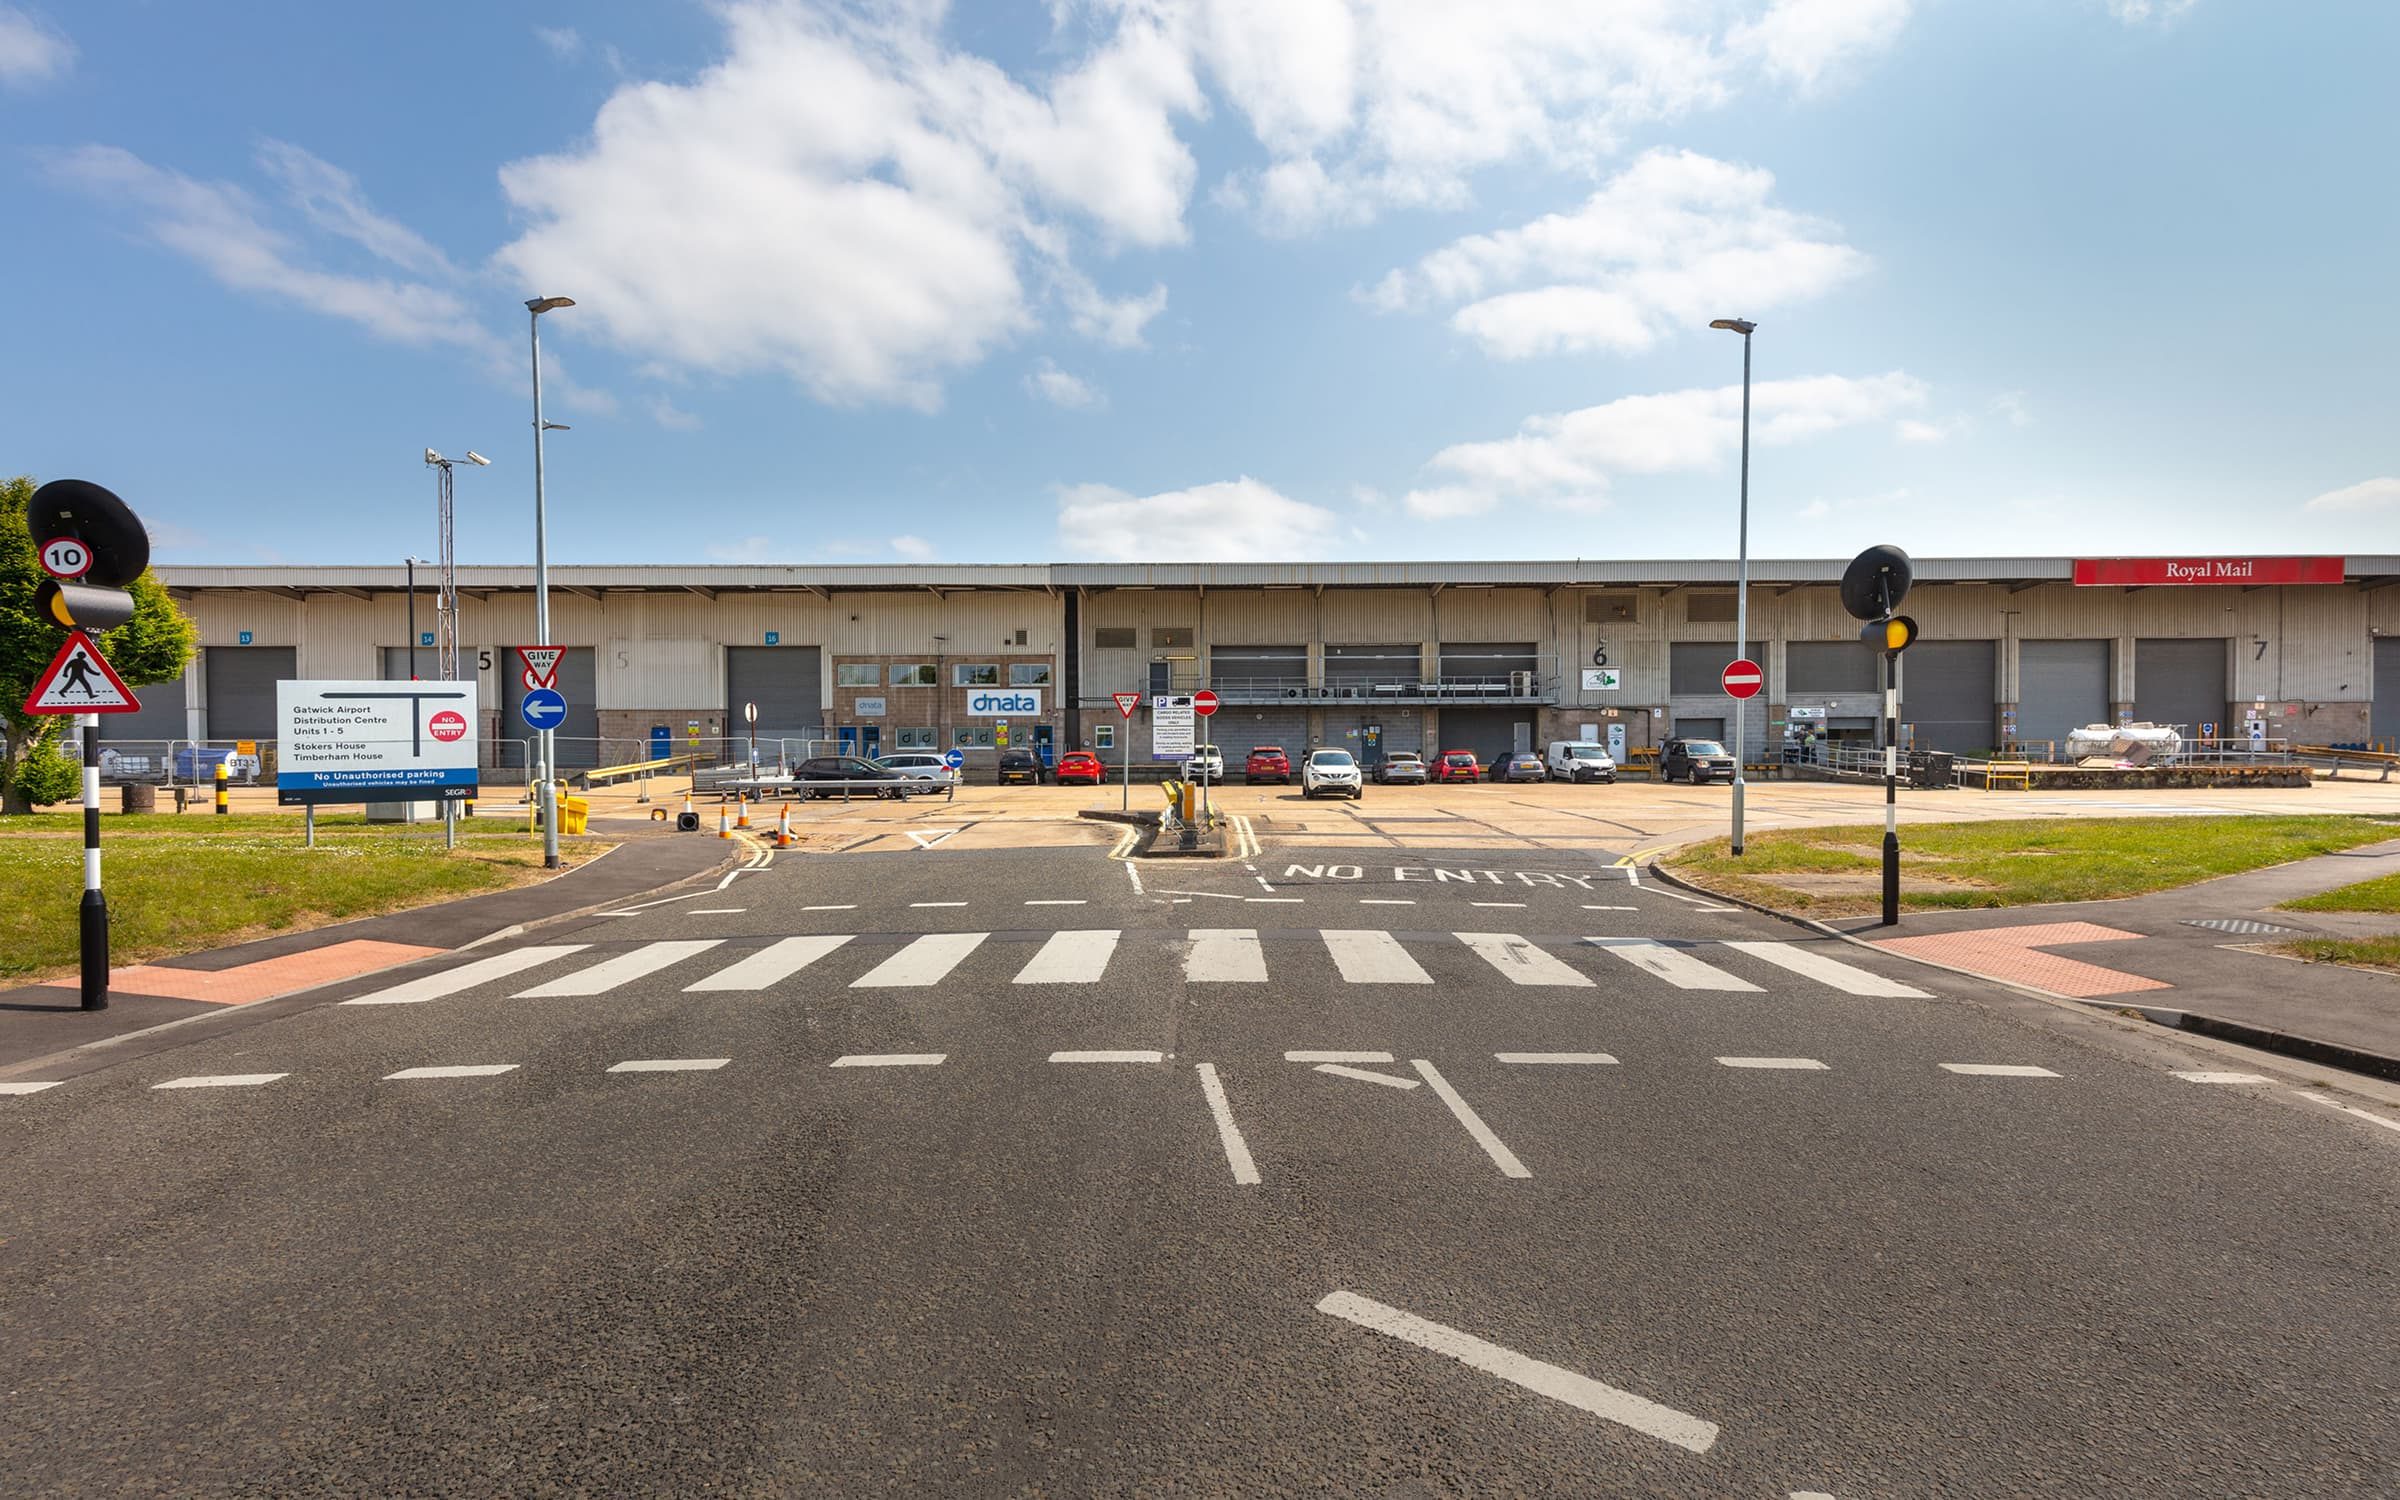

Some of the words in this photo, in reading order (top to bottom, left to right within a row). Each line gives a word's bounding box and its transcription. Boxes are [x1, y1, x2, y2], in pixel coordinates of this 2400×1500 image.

[50, 549, 81, 566] 10
[2166, 562, 2211, 581] Royal
[2216, 562, 2253, 577] Mail
[527, 651, 555, 660] GIVE
[1594, 647, 1607, 666] 6
[2254, 641, 2267, 660] 7
[479, 652, 491, 670] 5
[293, 706, 334, 714] Gatwick
[337, 706, 371, 714] Airport
[973, 694, 1034, 711] dnata
[1158, 698, 1165, 707] P
[294, 717, 351, 725] Distribution
[354, 717, 388, 725] Centre
[335, 742, 366, 750] House
[334, 772, 403, 780] Unauthorised
[407, 771, 445, 779] parking
[1285, 864, 1363, 879] NO
[1395, 867, 1594, 889] ENTRY
